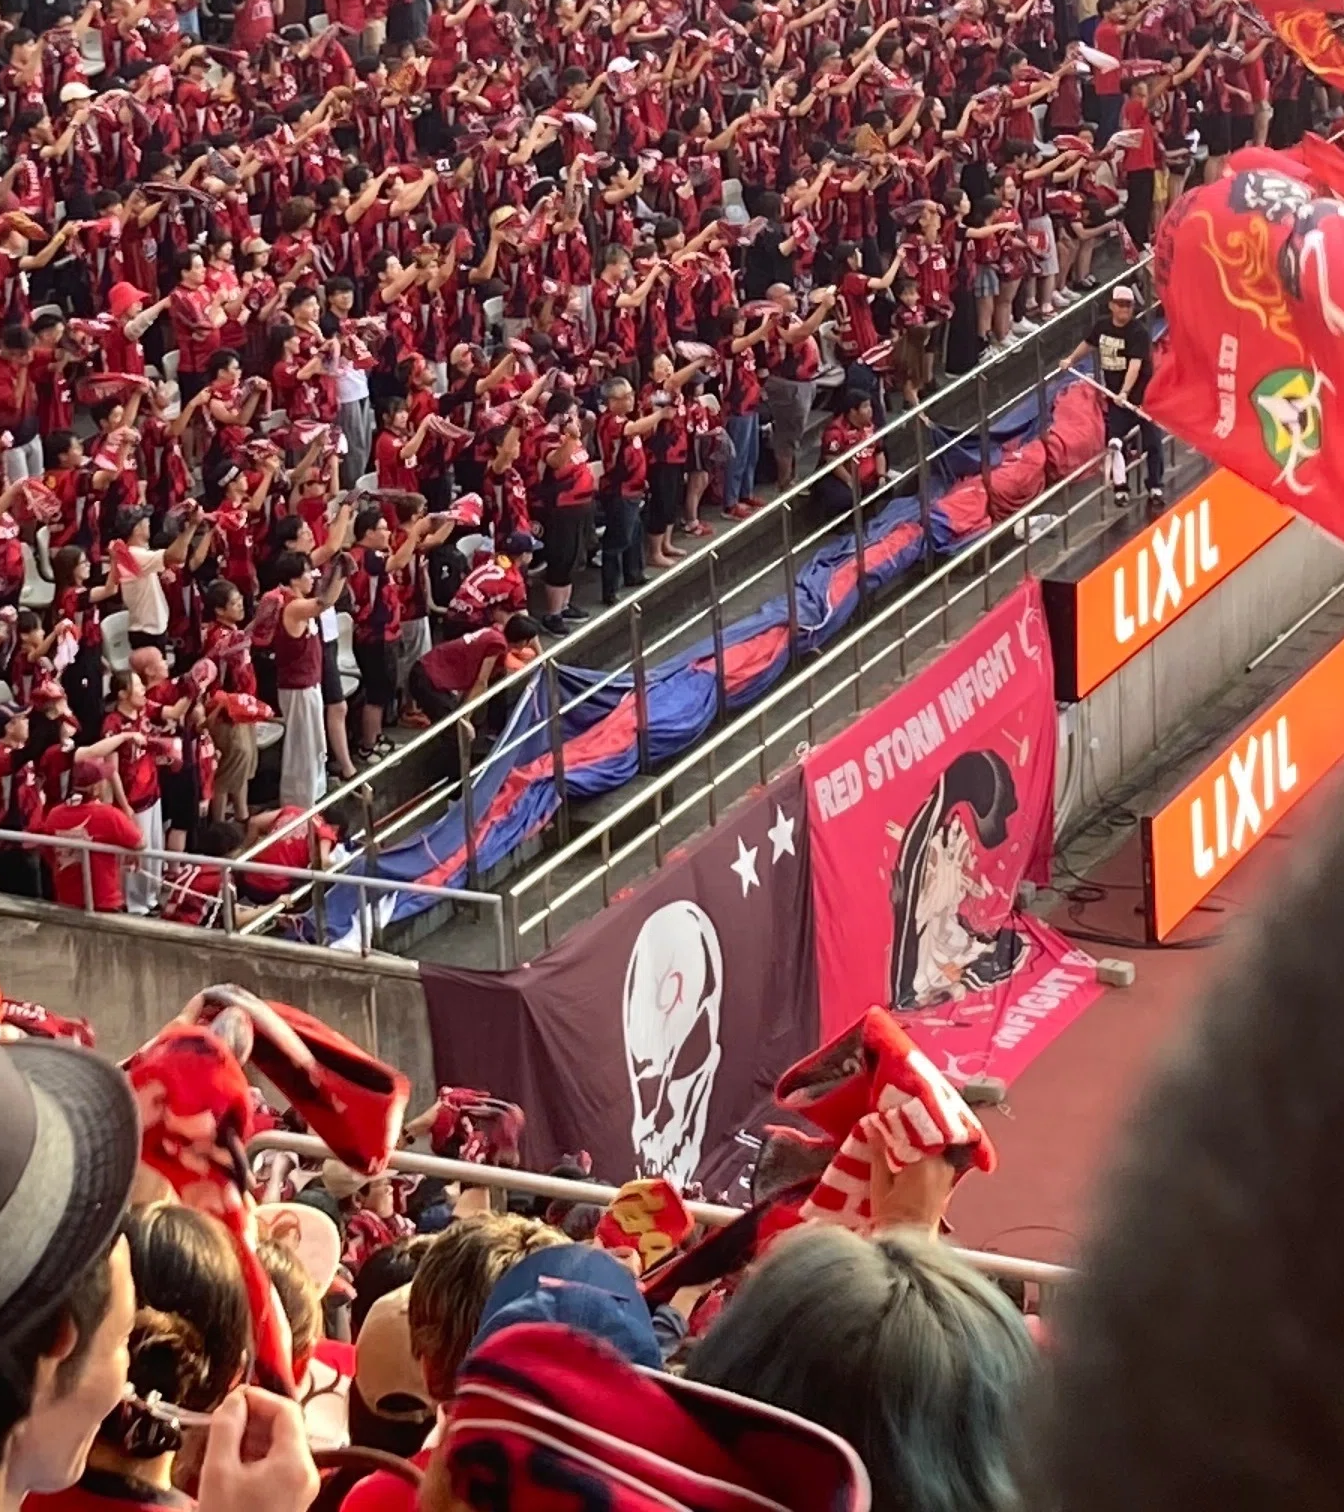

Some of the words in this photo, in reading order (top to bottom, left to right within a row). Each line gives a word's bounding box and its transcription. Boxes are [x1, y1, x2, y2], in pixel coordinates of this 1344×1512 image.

[1113, 498, 1220, 643] LIXIL
[814, 763, 863, 822] RED
[863, 706, 943, 791] STORM
[939, 634, 1018, 737] INFIGHT
[1190, 715, 1298, 879] LIXIL
